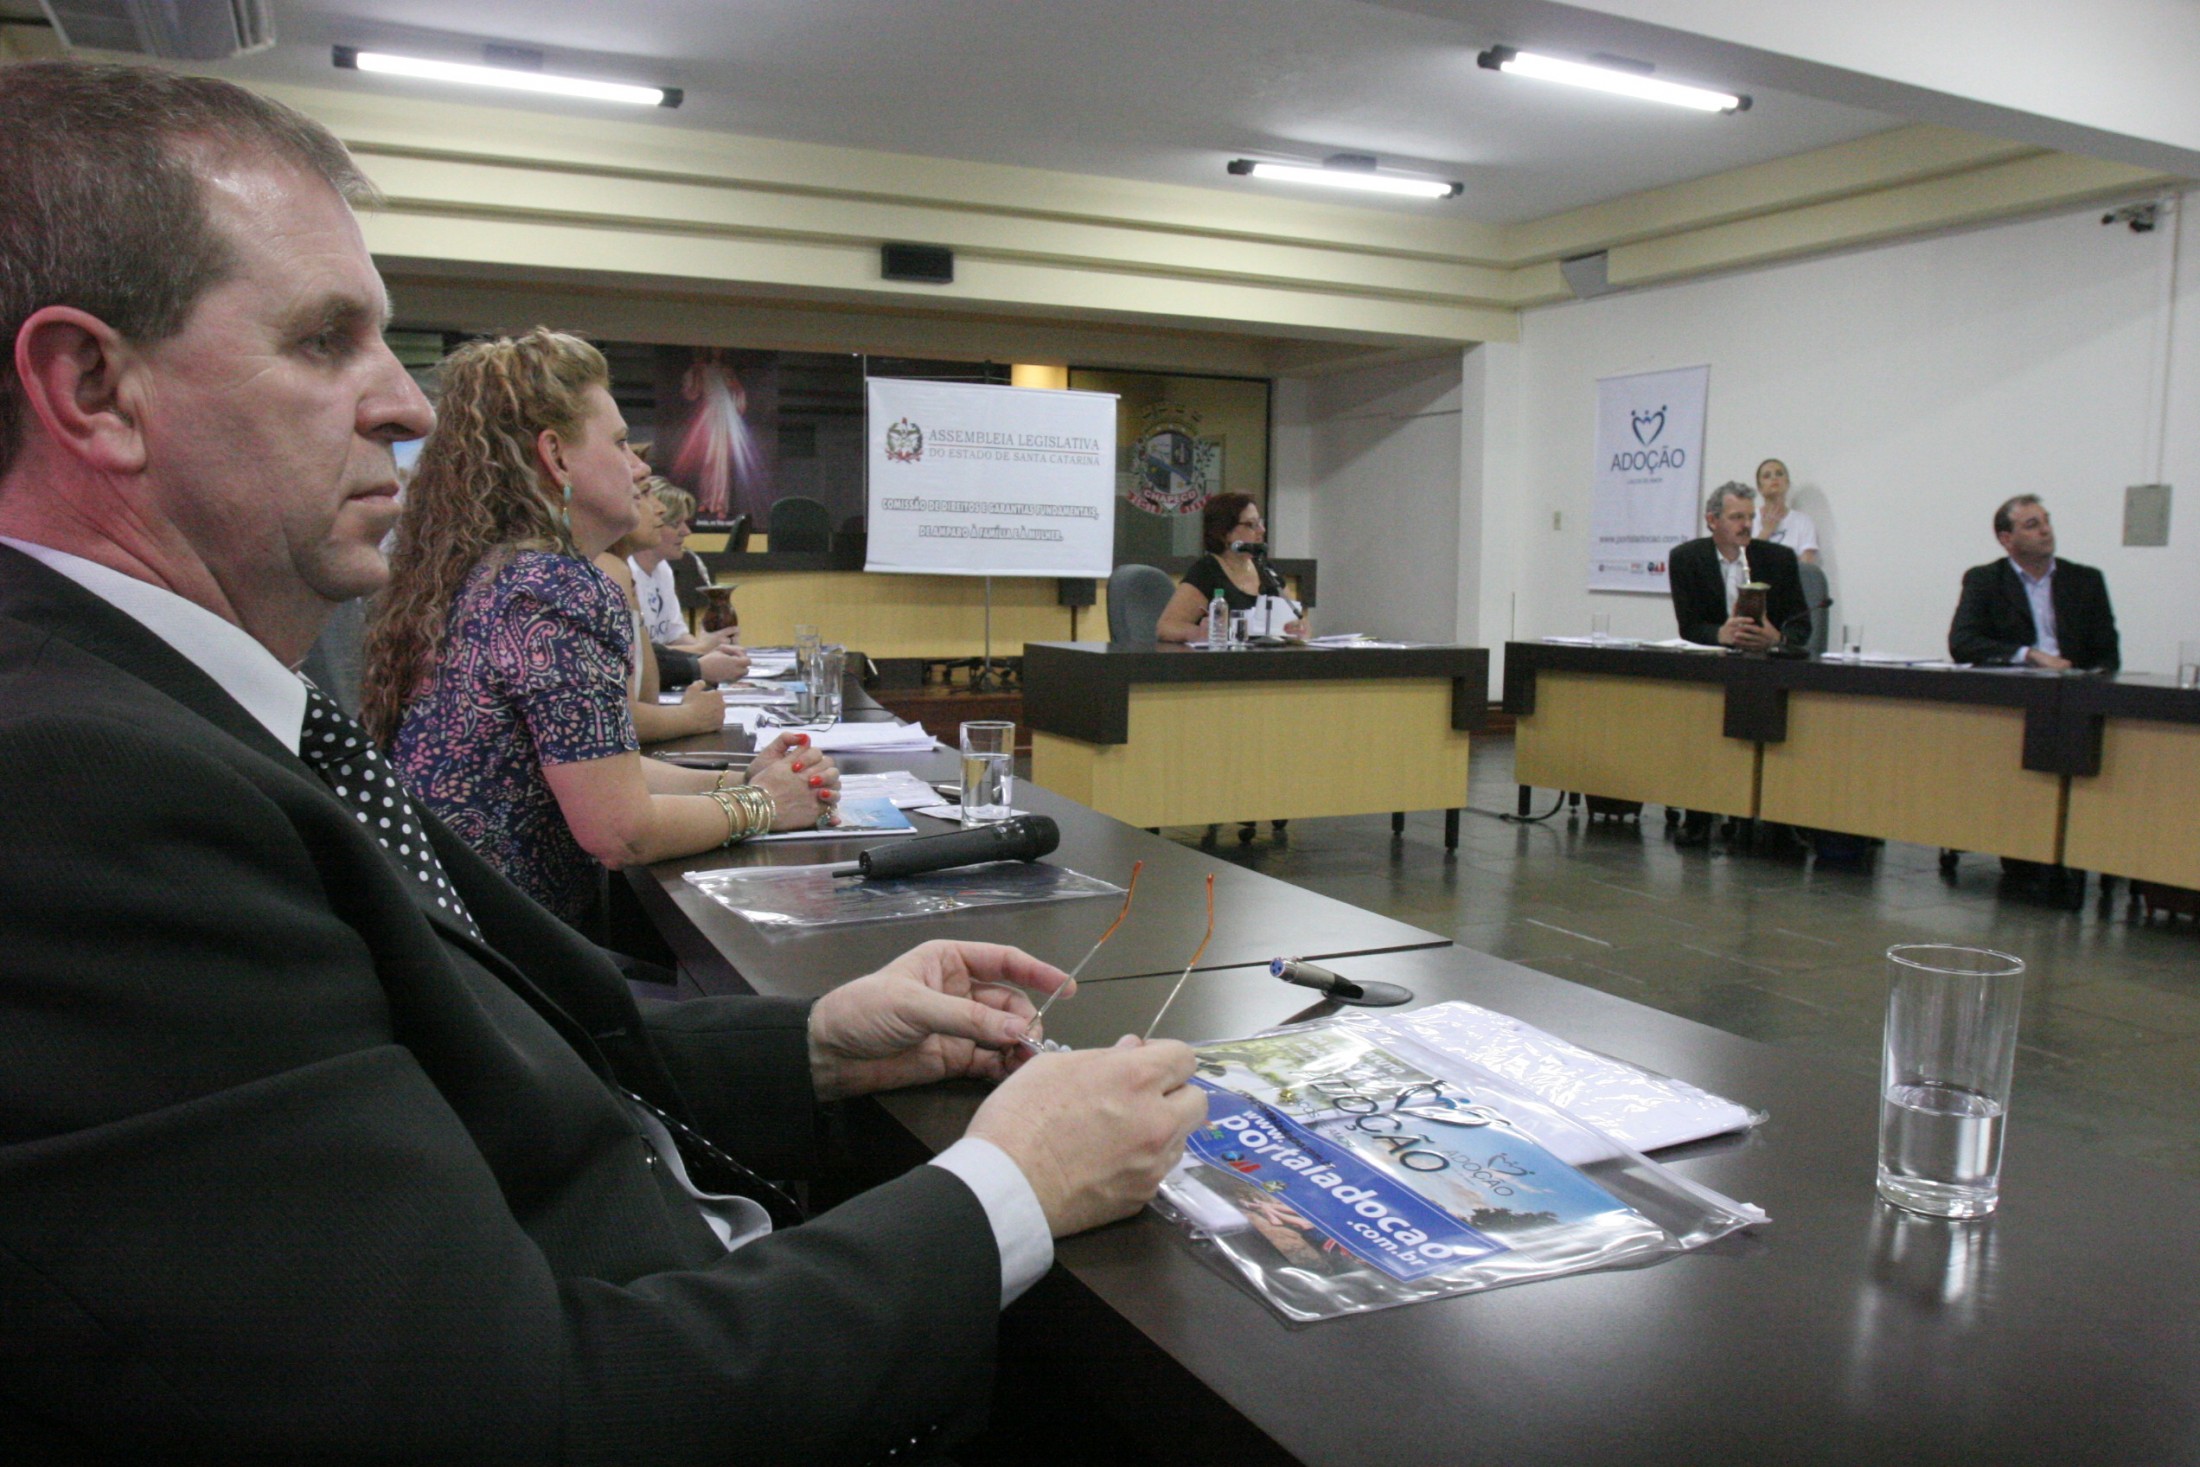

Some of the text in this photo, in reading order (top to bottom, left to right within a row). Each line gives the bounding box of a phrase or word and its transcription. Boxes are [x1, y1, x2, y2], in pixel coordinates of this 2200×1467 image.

[928, 429, 1100, 451] ASSEMBLEIA LEGISLATIVA
[928, 448, 1101, 467] DO ESTADO DE SANTA CATARINA
[1610, 445, 1686, 475] ADOÇÃO
[928, 499, 941, 512] DE
[989, 502, 1034, 516] GARANTIAS
[1210, 1114, 1453, 1259] portaladocao
[1445, 1149, 1515, 1197] ADOÇÃO
[1346, 1219, 1429, 1267] .com.br
